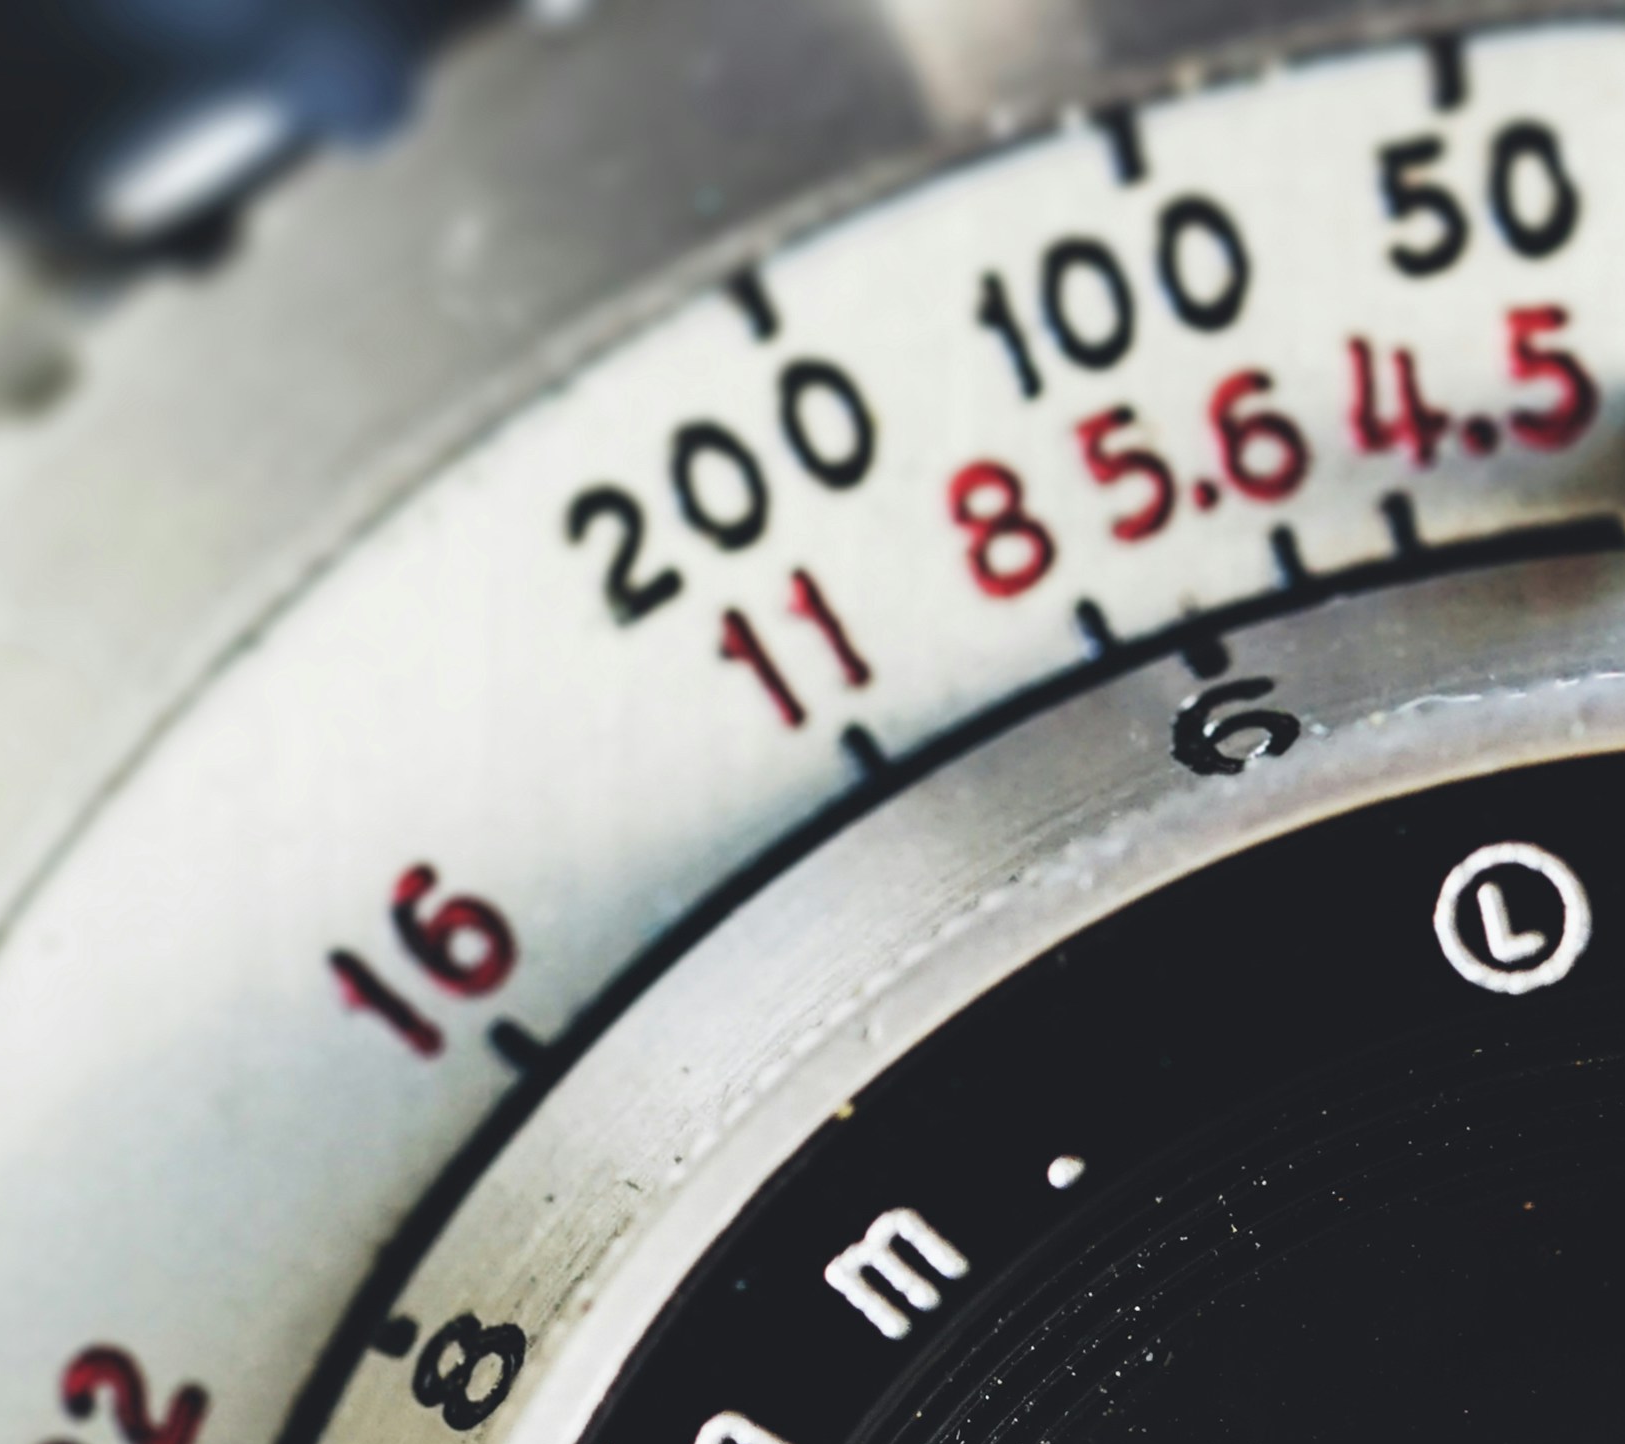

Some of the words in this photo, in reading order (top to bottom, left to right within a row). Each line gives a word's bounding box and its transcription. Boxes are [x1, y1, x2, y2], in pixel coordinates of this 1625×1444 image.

[1379, 121, 1580, 278] 50
[977, 192, 1251, 399] 100
[1076, 370, 1312, 544] 5.6
[1350, 307, 1599, 468] 4.5
[568, 359, 877, 627] 200
[946, 460, 1057, 599] 8
[719, 569, 871, 728] 11
[1172, 677, 1302, 775] 6
[328, 861, 520, 1060] 16
[411, 1312, 528, 1432] 8
